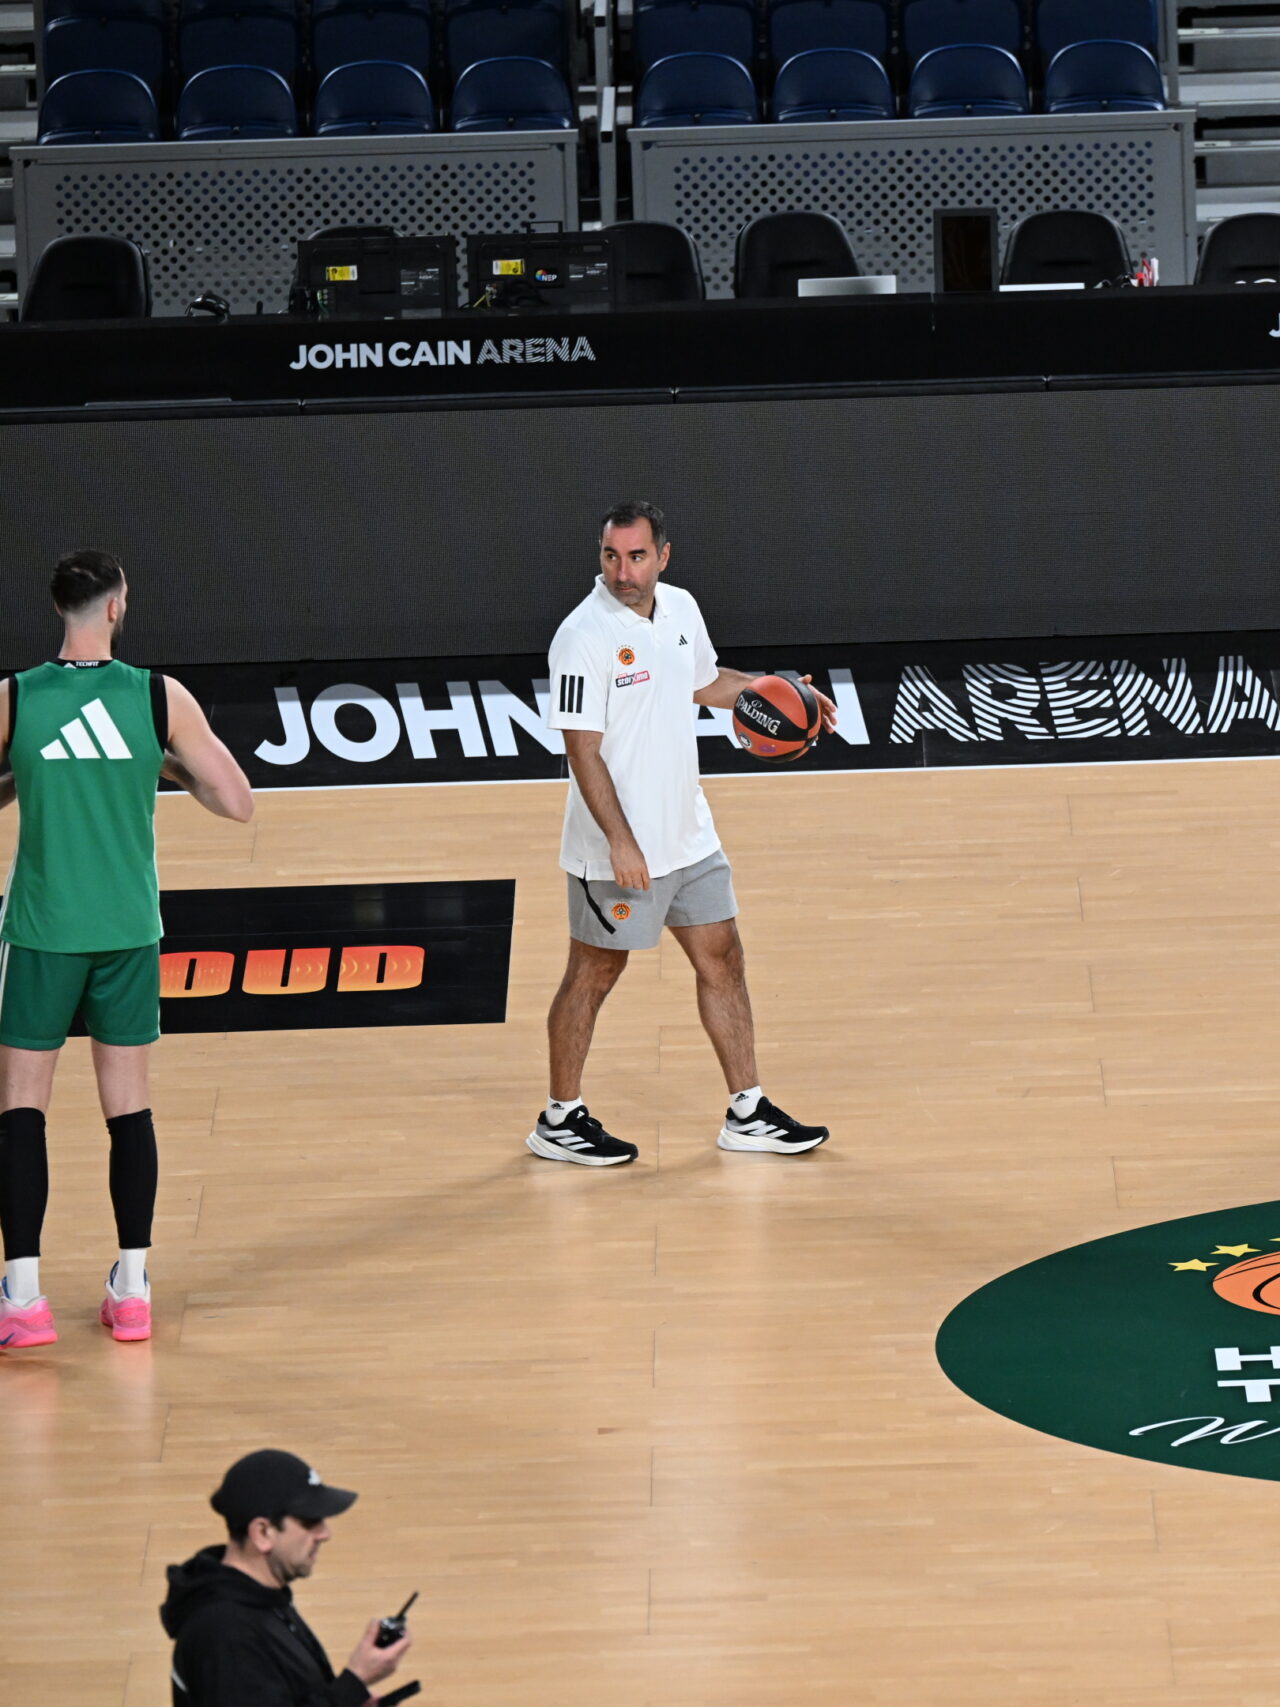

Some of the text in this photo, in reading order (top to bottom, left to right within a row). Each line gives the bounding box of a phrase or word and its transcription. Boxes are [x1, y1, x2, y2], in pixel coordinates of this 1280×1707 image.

[542, 274, 558, 282] NEP
[289, 336, 597, 370] JOHN CAIN ARENA
[254, 677, 566, 766] JOHN
[735, 694, 781, 736] SPALDING
